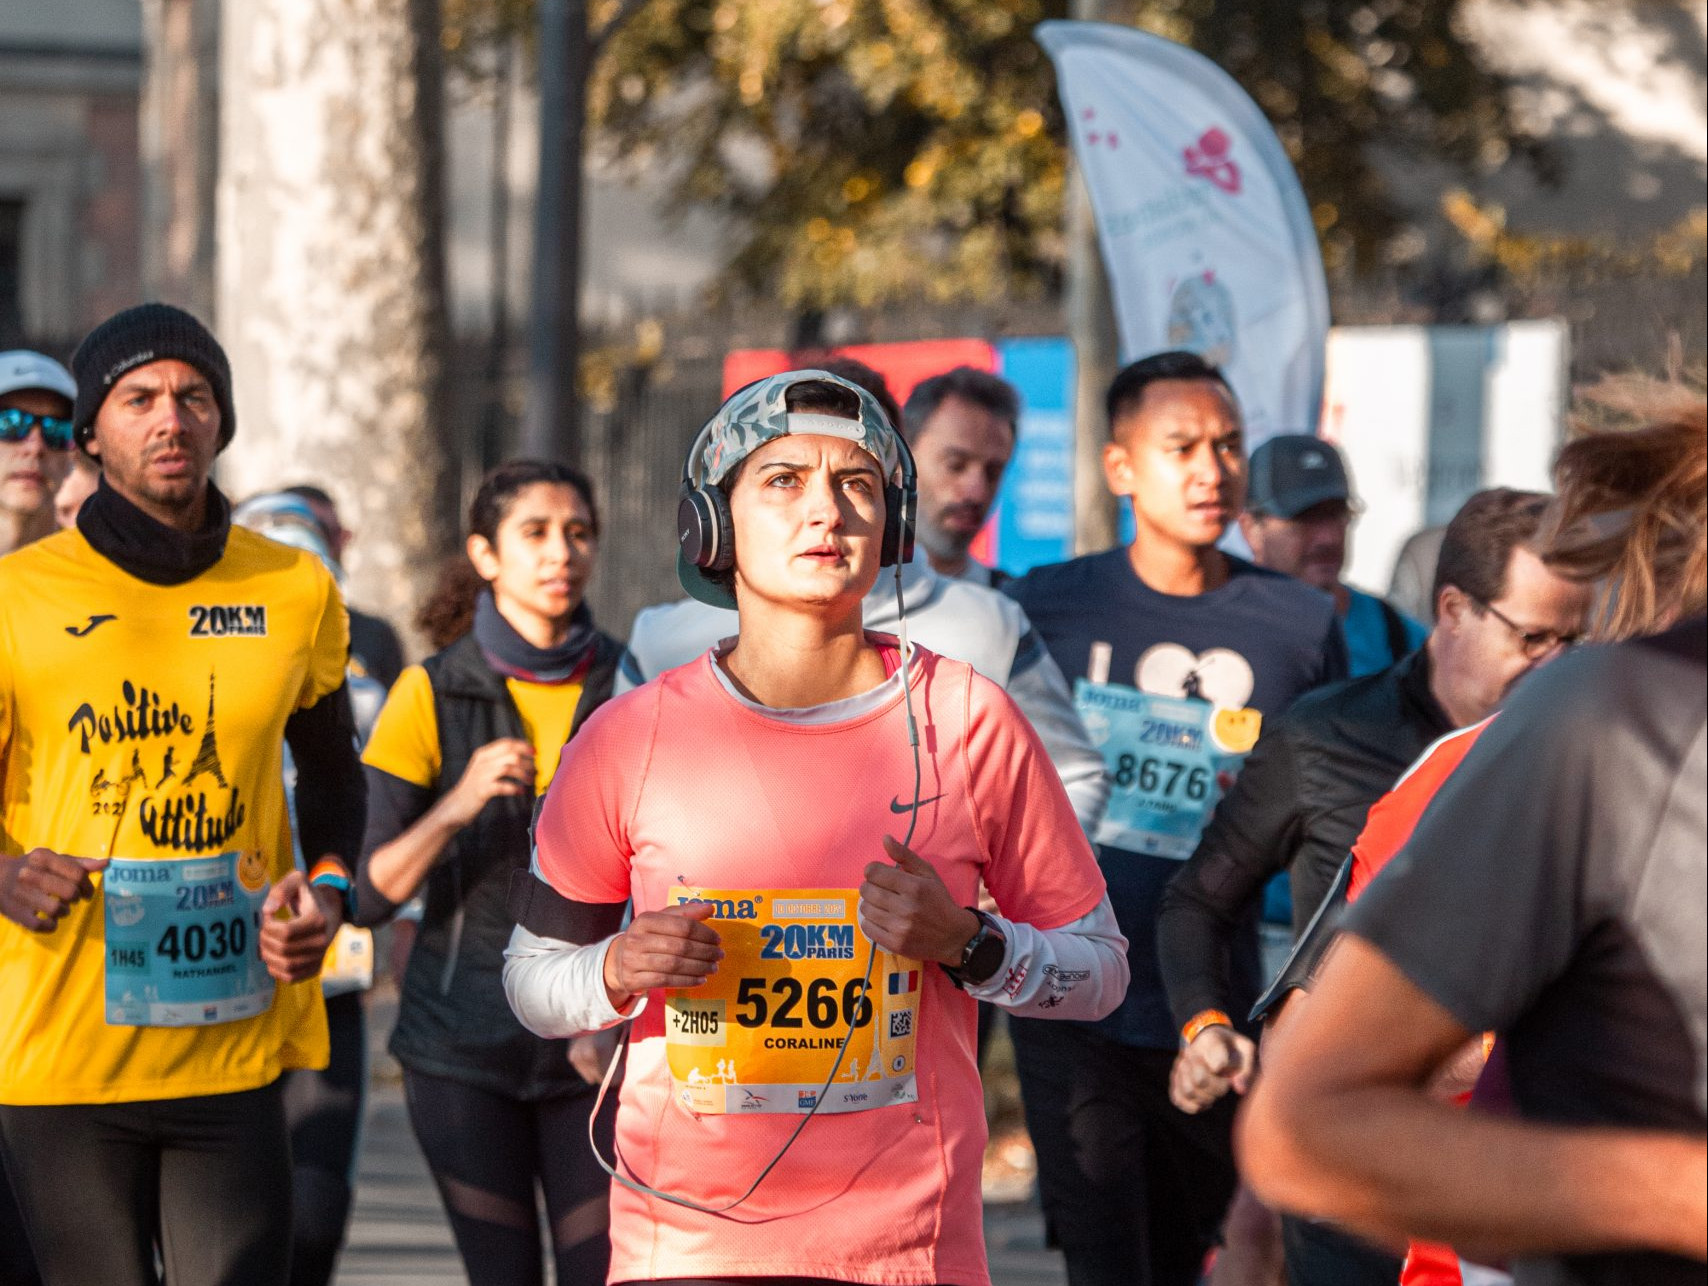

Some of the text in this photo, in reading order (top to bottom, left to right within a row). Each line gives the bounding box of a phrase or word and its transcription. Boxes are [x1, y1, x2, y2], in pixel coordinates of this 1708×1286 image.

[189, 605, 267, 636] 20KM
[68, 680, 195, 754] Positive
[1115, 753, 1208, 801] 8676
[786, 903, 822, 914] OCTOBRE
[157, 917, 247, 963] 4030
[760, 924, 855, 960] 20KM
[807, 947, 855, 960] PARIS
[111, 948, 146, 969] 1H45
[736, 977, 874, 1030] 5266
[672, 1010, 719, 1035] +2H05
[764, 1037, 845, 1050] CORALINE
